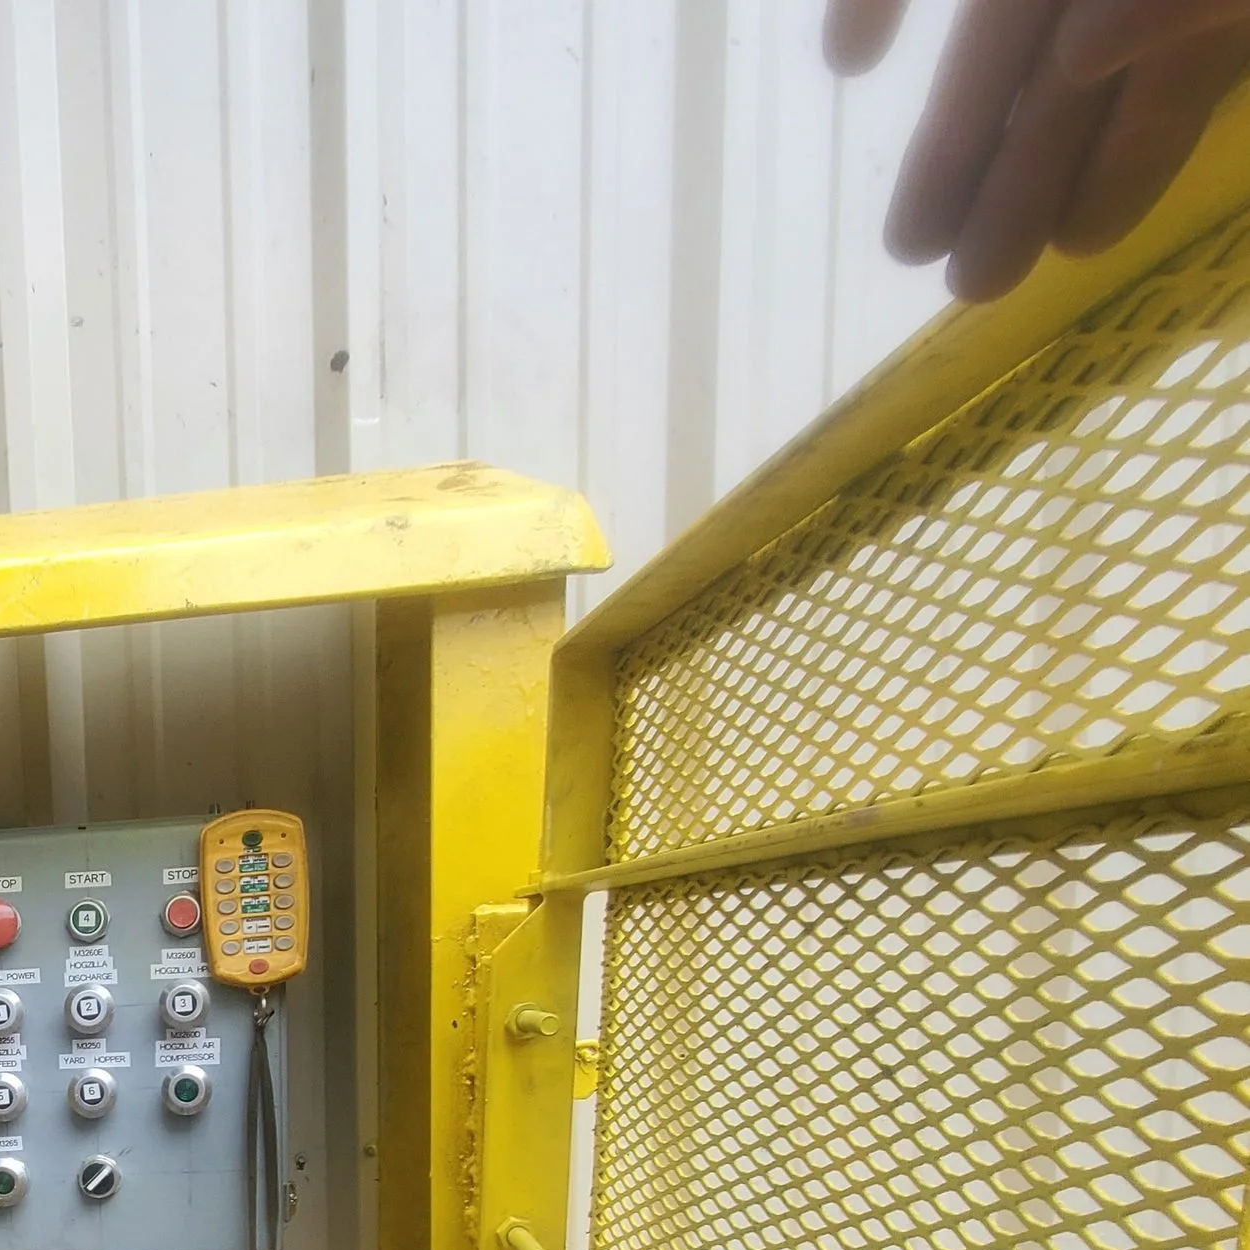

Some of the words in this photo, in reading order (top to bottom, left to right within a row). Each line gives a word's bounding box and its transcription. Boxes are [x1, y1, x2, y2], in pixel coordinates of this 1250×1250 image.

[69, 872, 107, 885] START
[167, 869, 198, 881] STOP
[83, 914, 90, 923] 4
[69, 960, 108, 969] HOGZILLA
[154, 966, 193, 976] HOGZILLA
[6, 972, 36, 981] POWER
[68, 973, 113, 983] DISCHARGE
[85, 1002, 93, 1012] 2
[180, 999, 187, 1008] 3
[159, 1043, 198, 1051] HOGZILLA
[202, 1042, 215, 1050] AIR
[63, 1057, 86, 1065] YARD
[94, 1055, 126, 1064] HOPPER
[159, 1053, 215, 1064] COMPRESSOR
[88, 1086, 95, 1096] 6
